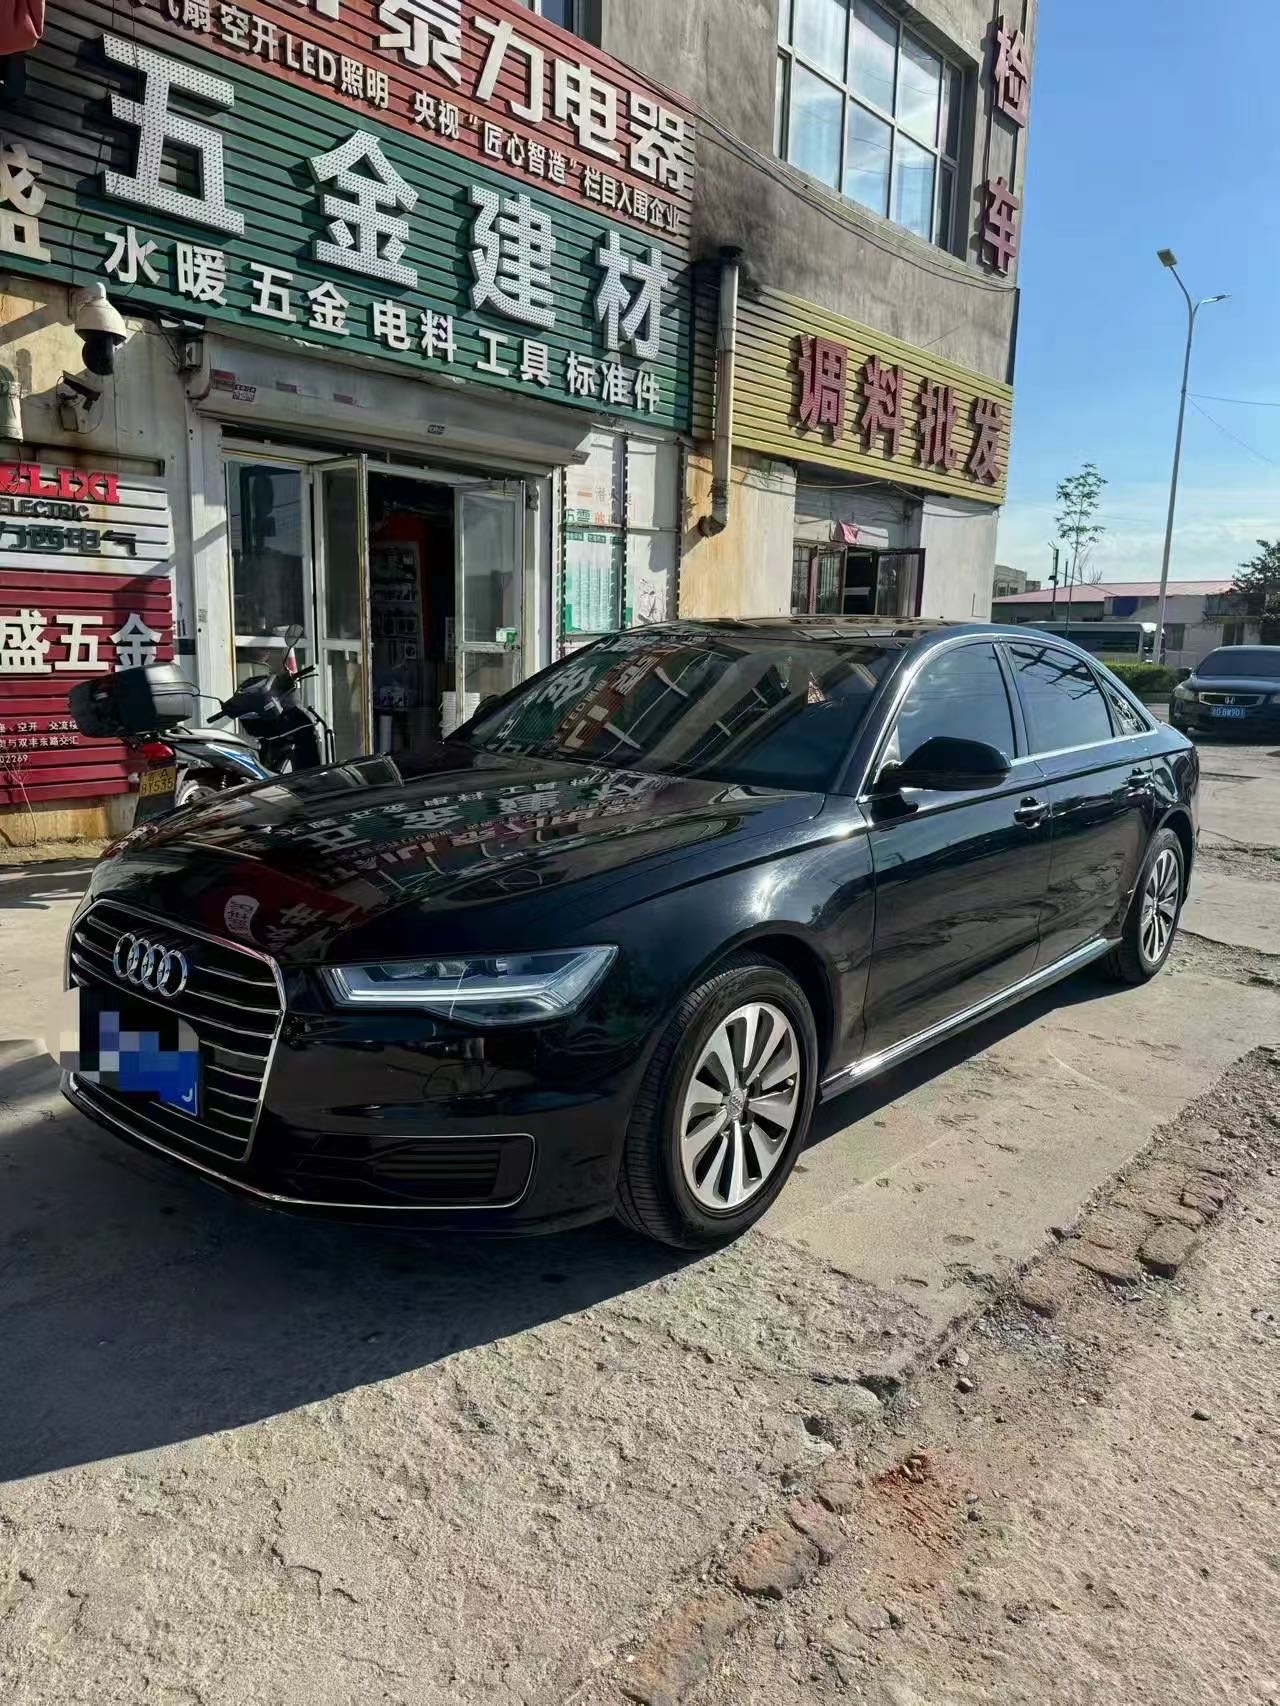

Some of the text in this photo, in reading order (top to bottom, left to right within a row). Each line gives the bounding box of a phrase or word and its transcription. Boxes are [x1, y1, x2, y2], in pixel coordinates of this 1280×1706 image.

[103, 33, 670, 360] 五金建材
[799, 334, 1003, 483] 调料批发
[0, 609, 162, 673] 盛五金
